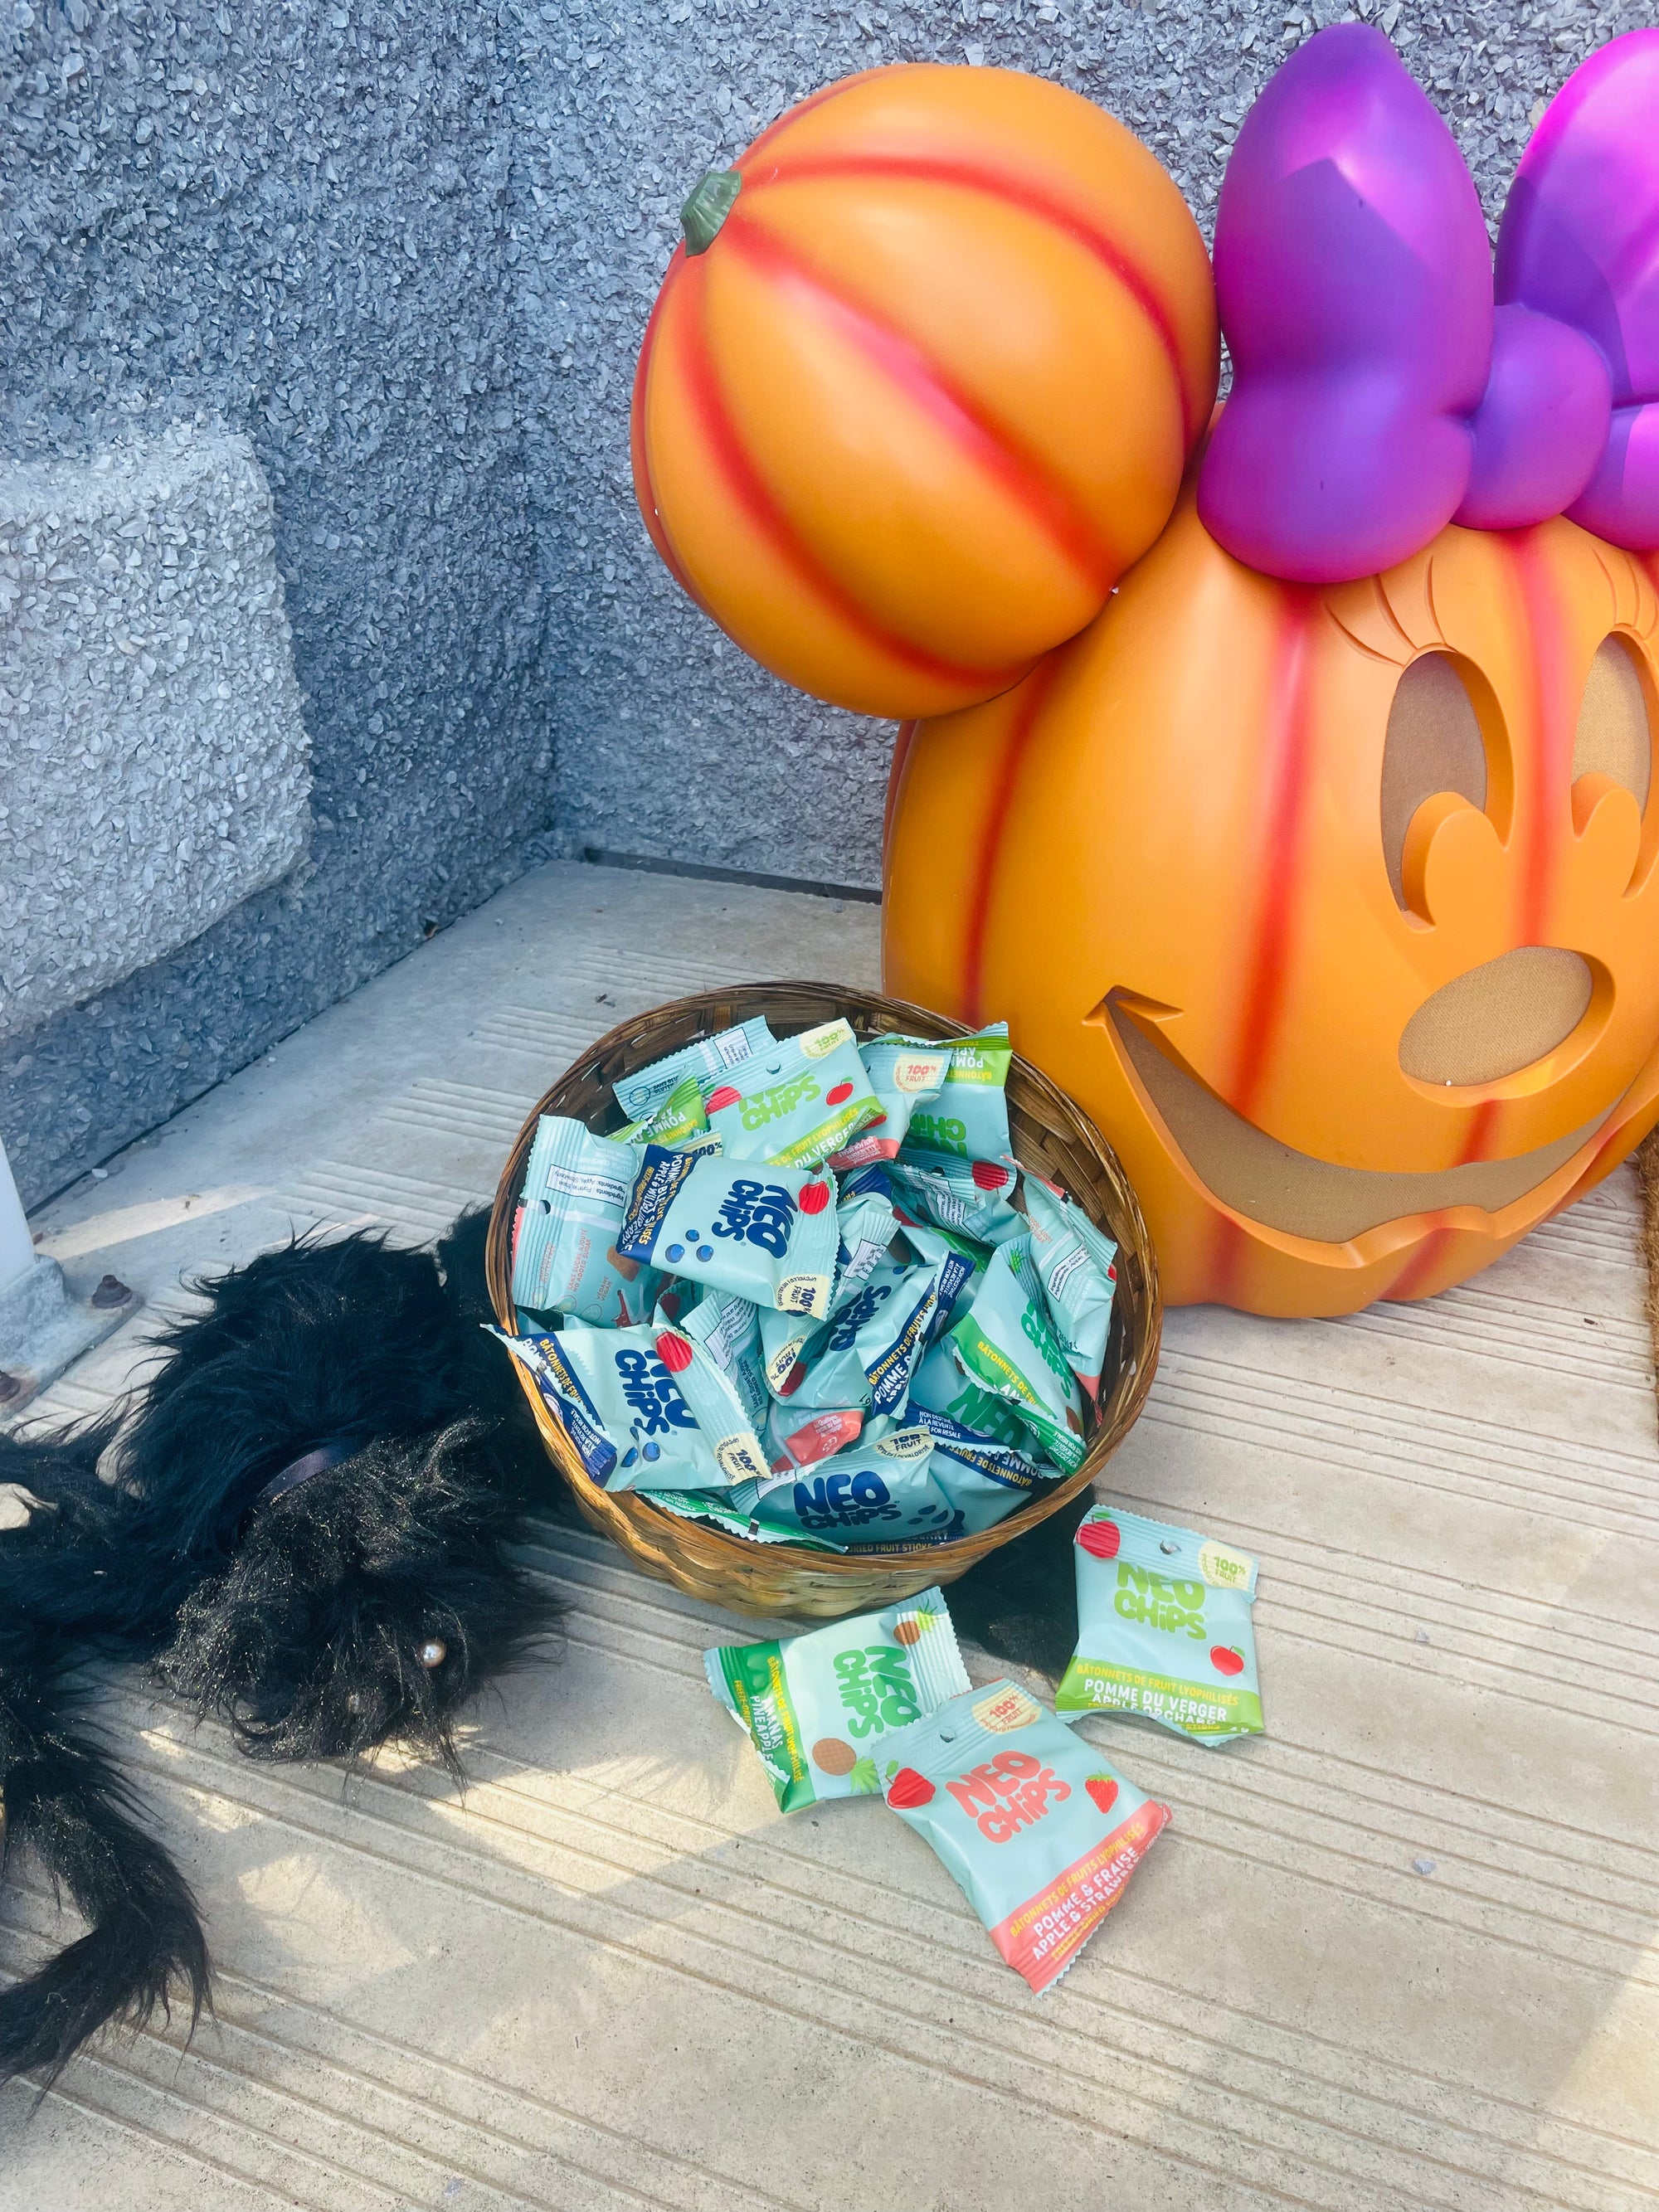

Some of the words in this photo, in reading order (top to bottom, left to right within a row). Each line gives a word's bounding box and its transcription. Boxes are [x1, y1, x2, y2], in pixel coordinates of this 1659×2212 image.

[907, 1065, 937, 1076] 100%
[947, 1070, 992, 1082] BÂTONNET
[951, 1057, 984, 1068] POM
[791, 1137, 811, 1156] FRUIT
[812, 1107, 859, 1142] LYOPHILISÉS
[747, 1184, 798, 1259] NEO
[790, 1285, 802, 1304] FRUIT
[540, 1339, 567, 1380] BÂTONNETS
[868, 1344, 907, 1386] BÂTONNETS
[907, 1310, 927, 1339] FRUITS
[977, 1341, 1019, 1383] BÂTONNETS
[1017, 1381, 1029, 1394] DE
[874, 1363, 907, 1404] POMME
[896, 1439, 922, 1451] FRUIT
[931, 1427, 941, 1435] FOR
[942, 1428, 961, 1439] RESALE
[727, 1452, 744, 1471] FRUIT
[987, 1462, 1034, 1487] BÂTONNETS
[793, 1471, 890, 1517] NEO
[876, 1544, 899, 1553] FRUIT
[1214, 1556, 1246, 1575] 100%
[1117, 1561, 1205, 1611] NEO
[1215, 1568, 1236, 1583] FRUIT
[777, 1699, 786, 1711] DE
[864, 1646, 922, 1728] NEO
[1077, 1664, 1132, 1684] BÂTONNETS
[1134, 1674, 1147, 1685] DE
[1148, 1676, 1177, 1692] FRUIT
[1179, 1684, 1238, 1706] LYOPHILISÉS
[1084, 1679, 1138, 1703] POMME
[1142, 1690, 1165, 1708] DU
[1169, 1696, 1228, 1722] VERGER
[761, 1696, 783, 1750] ANANAS
[990, 1694, 1019, 1718] 100%
[750, 1695, 774, 1762] PINEAPPLE
[945, 1750, 1041, 1818] NEO
[1010, 1891, 1059, 1938] BÂTONNETS
[1058, 1882, 1070, 1897] DE
[1067, 1860, 1099, 1890] FRUITS
[1097, 1822, 1145, 1864] LYOPHILISÉS
[1033, 1892, 1082, 1938] POMME
[1081, 1884, 1094, 1897] &
[1092, 1847, 1139, 1888] FRAISE
[1032, 1919, 1071, 1961] APPLE
[1069, 1910, 1082, 1923] &
